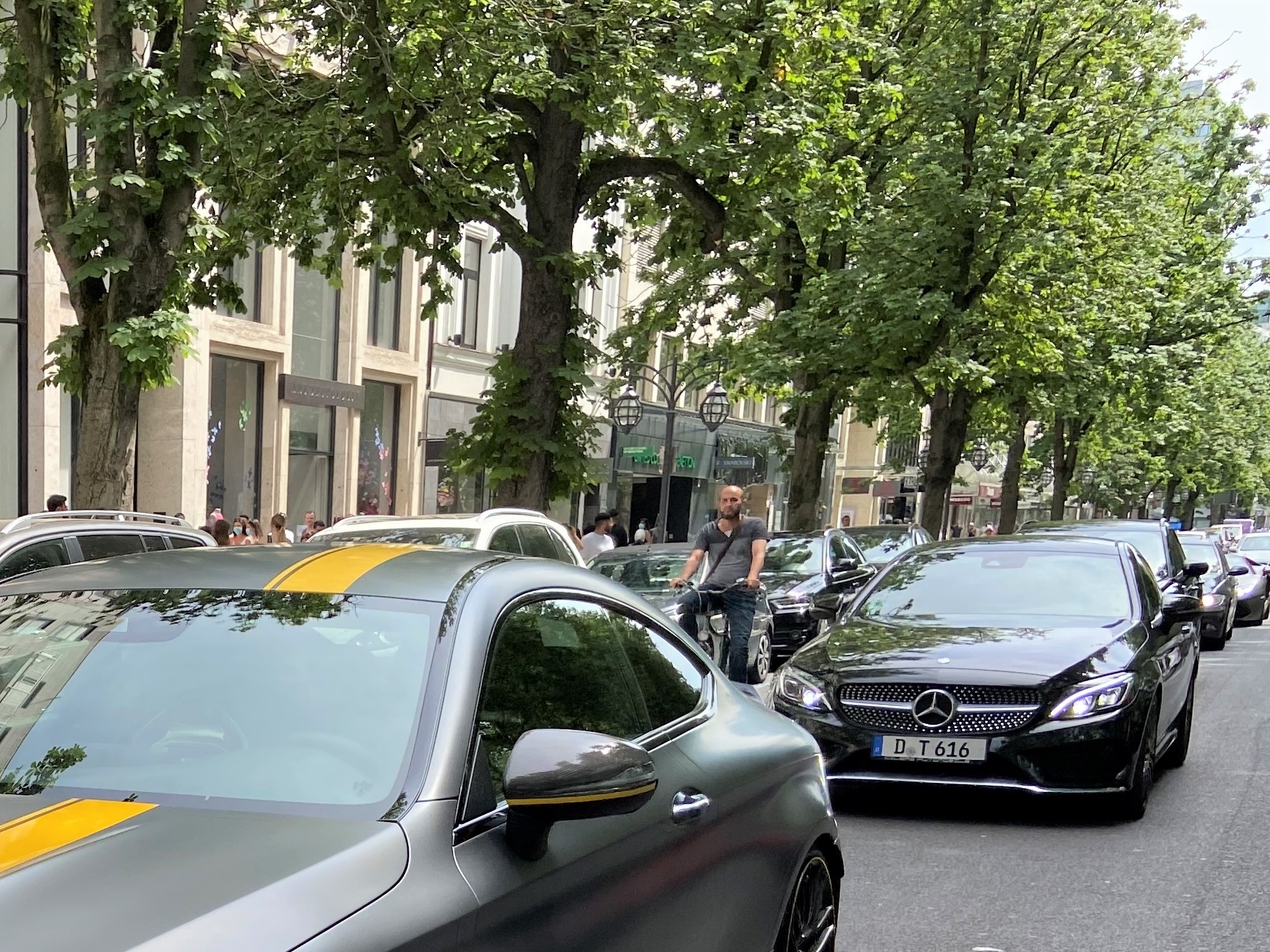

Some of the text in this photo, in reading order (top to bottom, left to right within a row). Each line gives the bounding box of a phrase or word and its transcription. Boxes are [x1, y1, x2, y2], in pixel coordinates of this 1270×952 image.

[894, 738, 970, 758] D T 616
